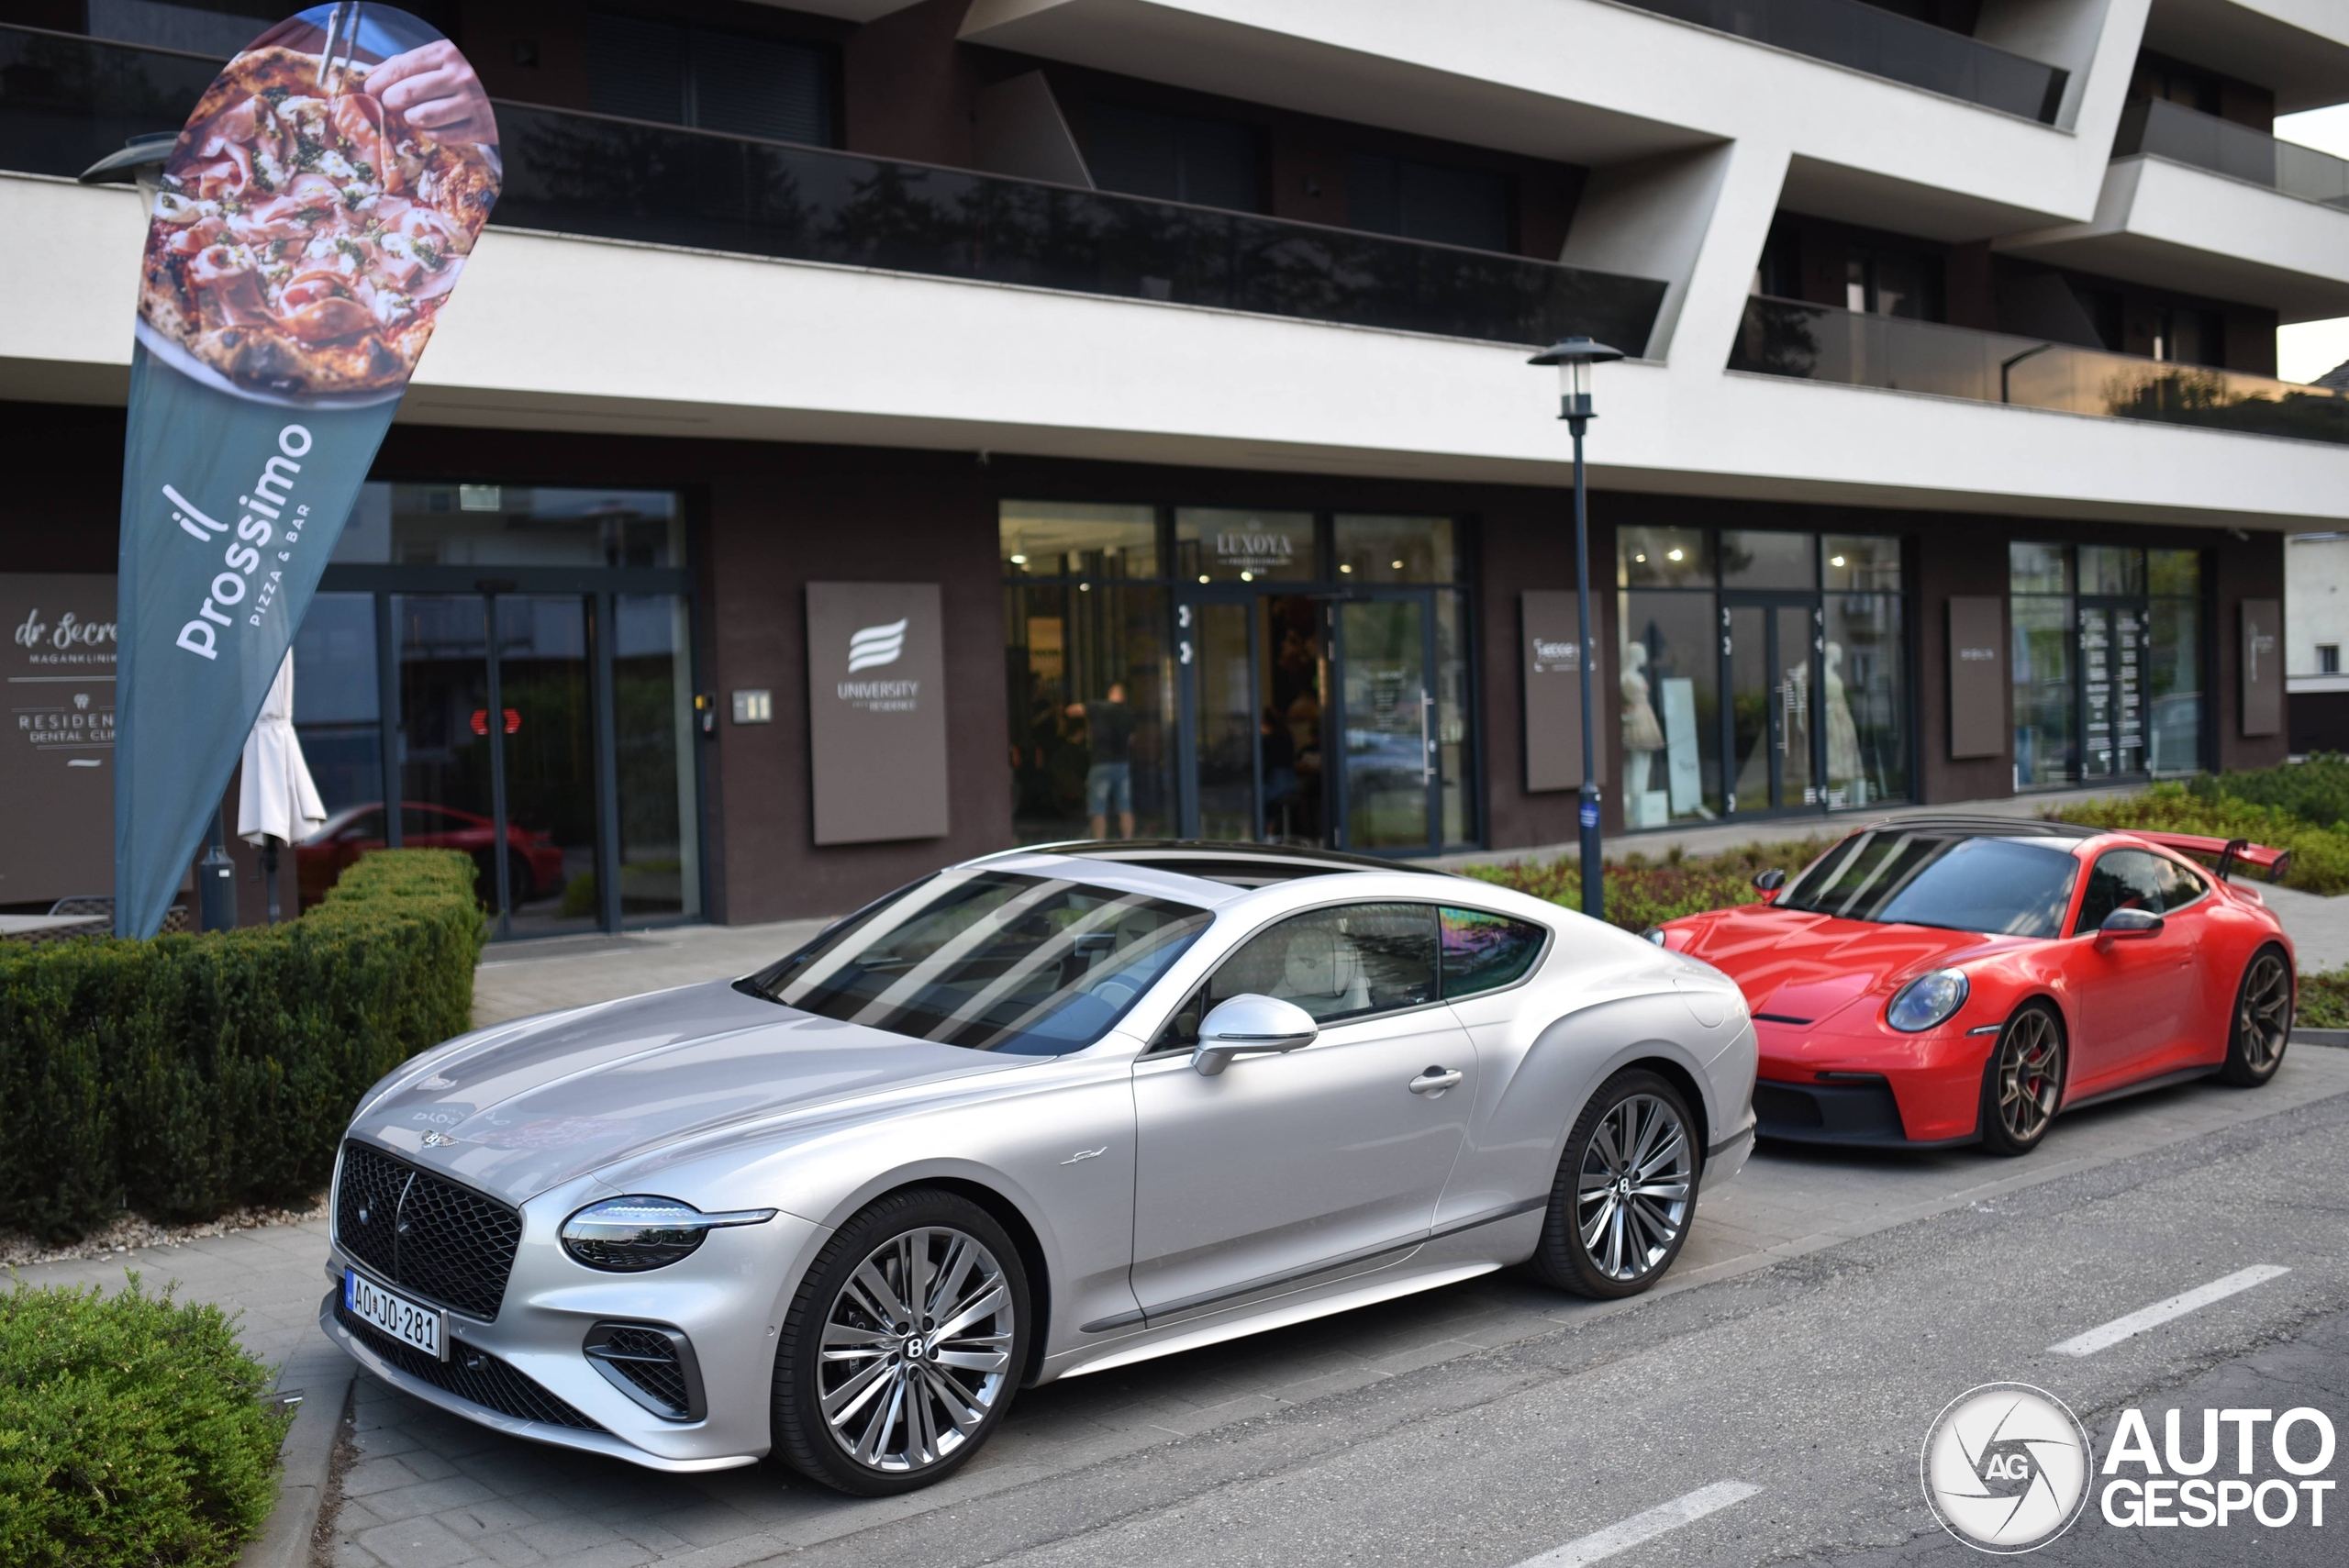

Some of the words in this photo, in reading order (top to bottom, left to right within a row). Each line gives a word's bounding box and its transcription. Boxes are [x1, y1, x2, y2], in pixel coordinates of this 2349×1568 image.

[162, 484, 228, 542] il
[1217, 532, 1293, 556] LUXOYA
[249, 571, 283, 627] PIZZA
[277, 550, 290, 562] &
[284, 504, 310, 543] BAR
[837, 680, 919, 700] UNIVERSITY
[29, 731, 83, 744] DENTAL
